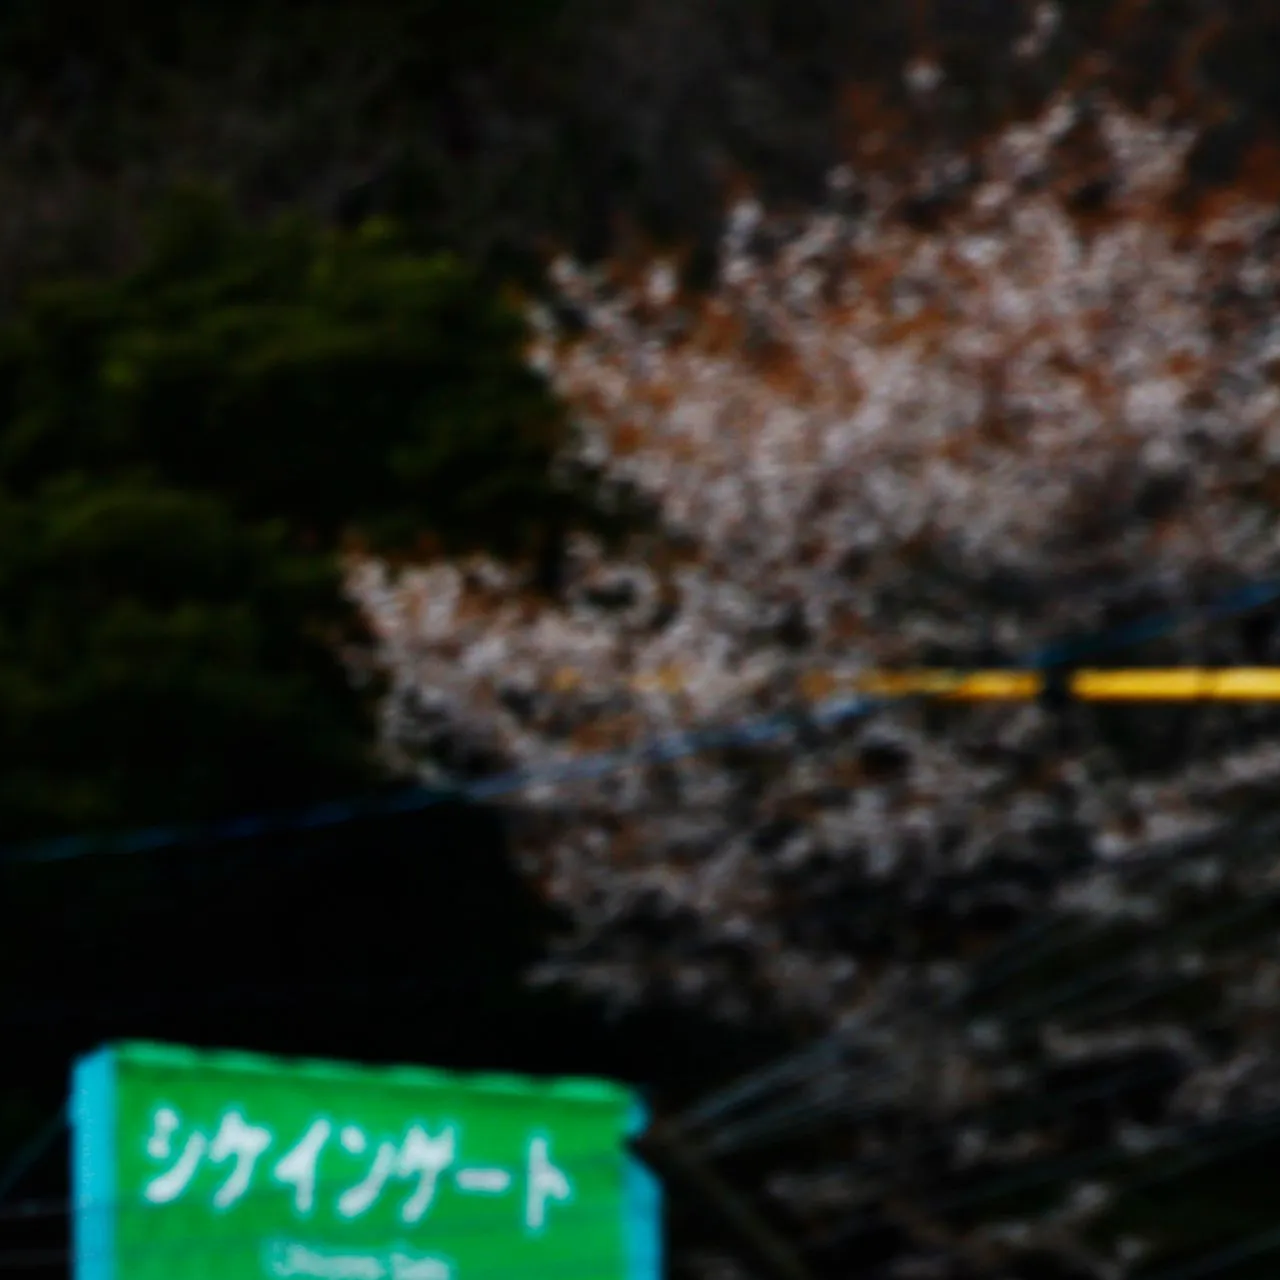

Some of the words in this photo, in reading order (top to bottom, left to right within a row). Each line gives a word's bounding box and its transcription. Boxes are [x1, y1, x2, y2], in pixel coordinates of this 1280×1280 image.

[144, 1106, 572, 1230] シケインゲート
